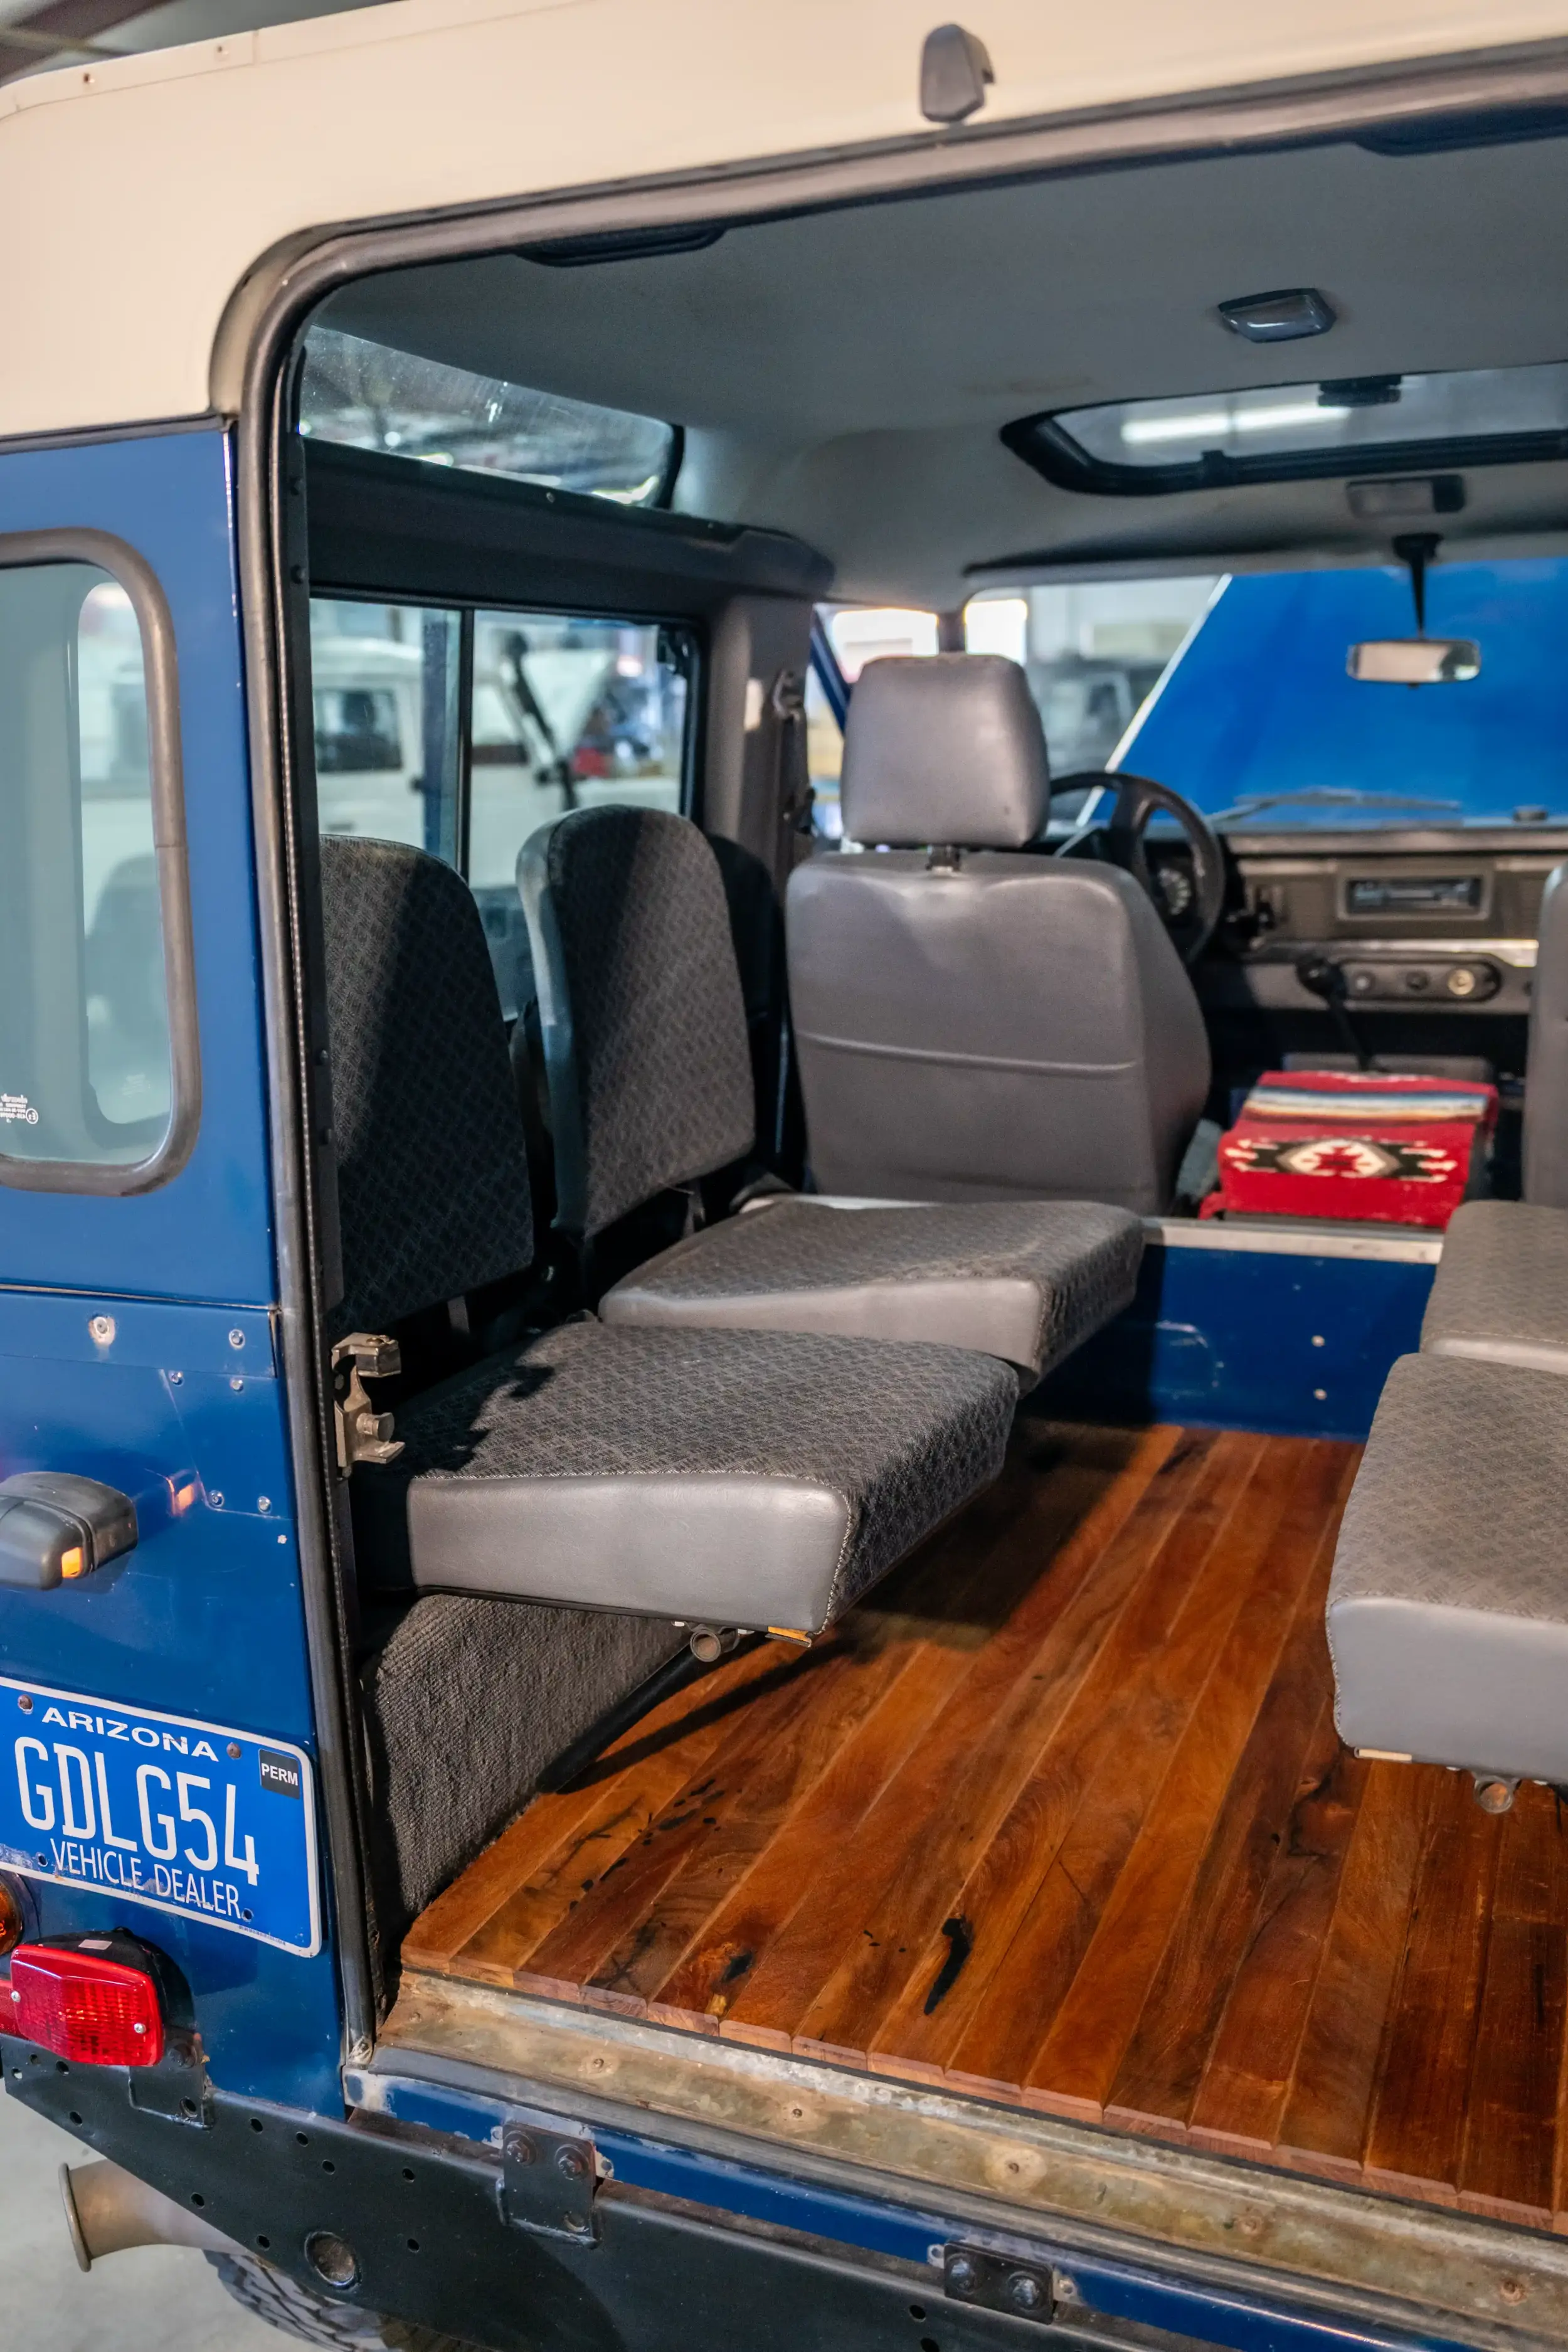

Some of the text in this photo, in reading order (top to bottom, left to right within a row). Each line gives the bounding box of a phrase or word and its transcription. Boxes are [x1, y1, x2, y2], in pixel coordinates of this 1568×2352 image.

[41, 1707, 219, 1762] ARIZONA
[260, 1764, 299, 1786] PERM
[50, 1838, 241, 1919] VEHICLE DEALER
